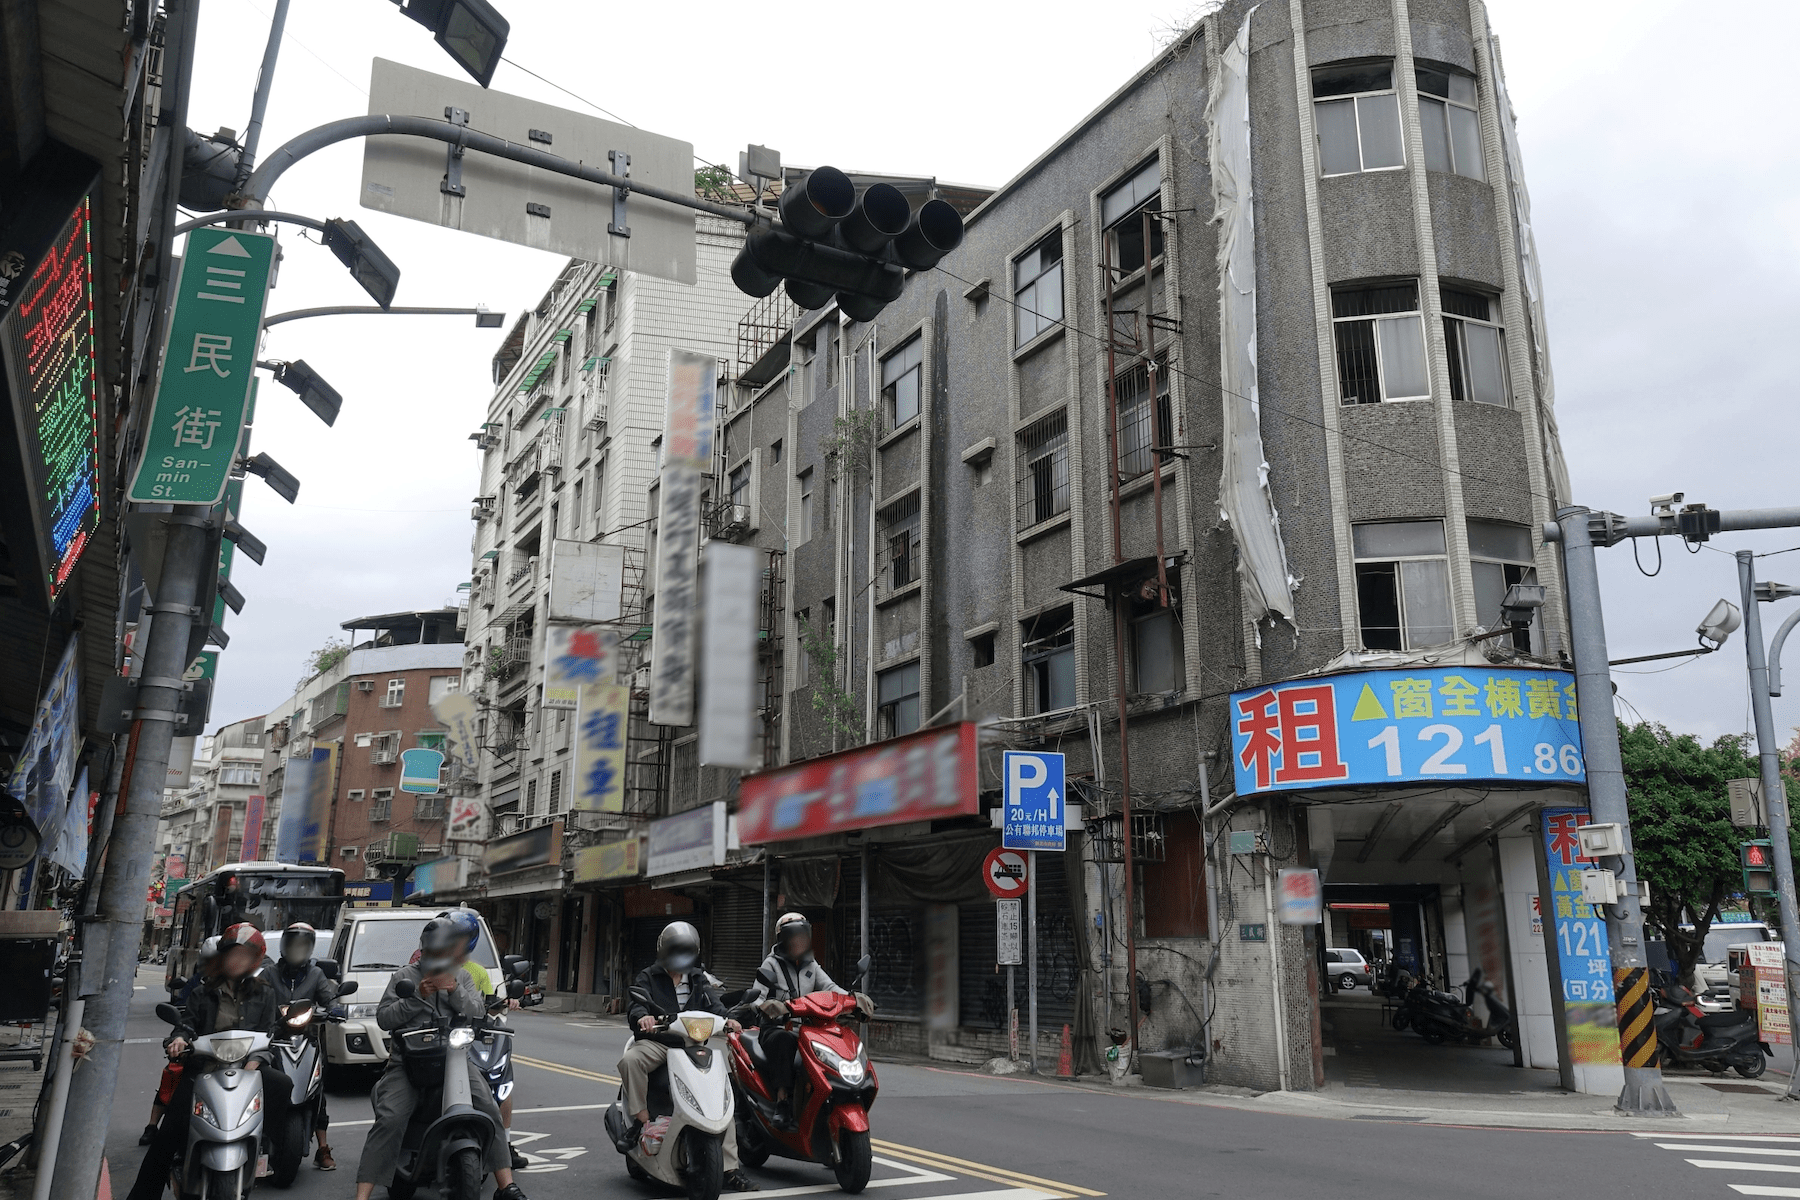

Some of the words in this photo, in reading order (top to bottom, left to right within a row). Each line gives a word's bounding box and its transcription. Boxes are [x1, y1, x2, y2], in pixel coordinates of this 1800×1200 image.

[171, 266, 246, 450] 三民街
[161, 455, 212, 470] San-
[156, 471, 191, 483] min
[151, 484, 176, 498] St.
[1237, 683, 1349, 790] 租
[1367, 723, 1587, 777] 121.86
[1009, 755, 1048, 806] P
[1011, 808, 1048, 822] 20元/H
[1005, 823, 1064, 837] 公有聯邦停車場
[1587, 959, 1607, 978] 坪
[1562, 979, 1615, 1000] (可分
